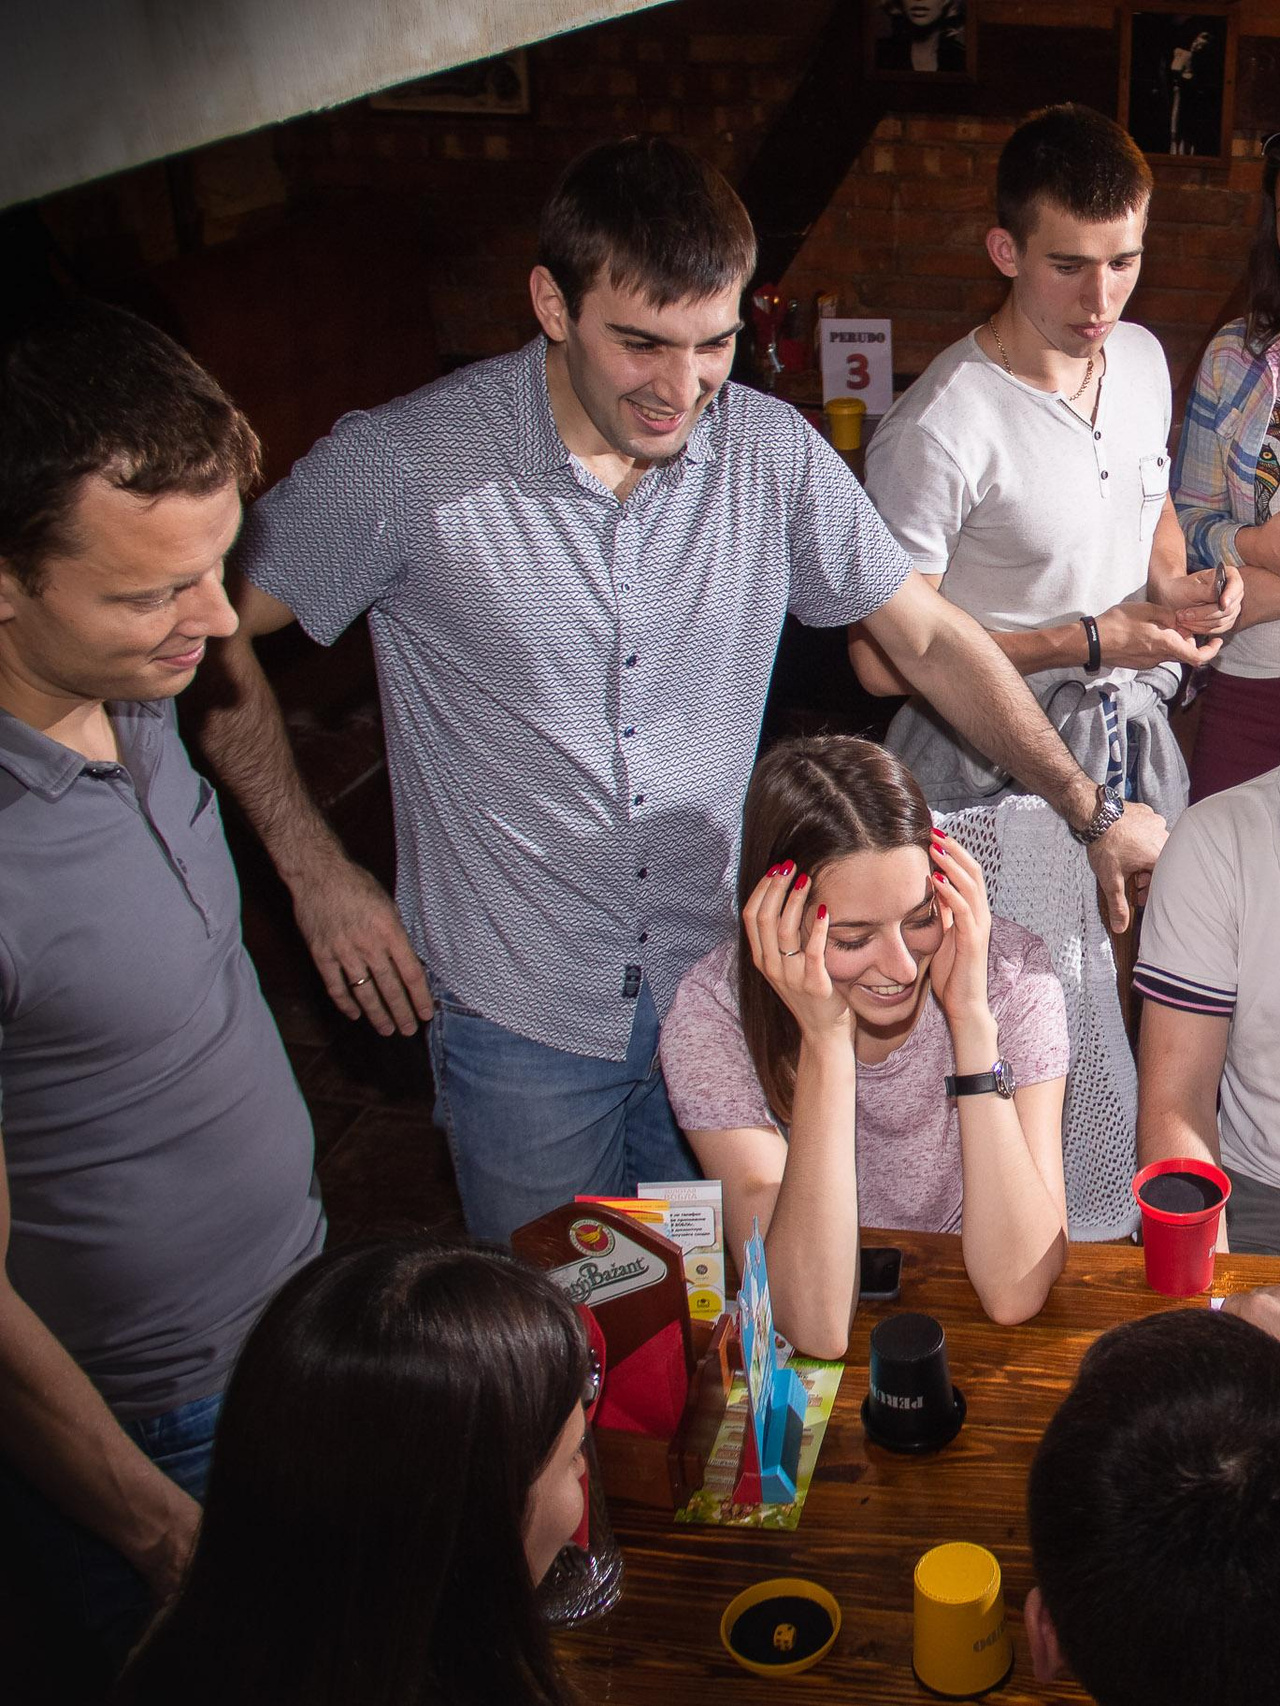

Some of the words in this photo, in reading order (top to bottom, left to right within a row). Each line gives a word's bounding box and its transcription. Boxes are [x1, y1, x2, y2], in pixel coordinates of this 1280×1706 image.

[829, 331, 886, 343] PERUDO
[846, 353, 871, 390] 3
[579, 1257, 650, 1287] Bažant
